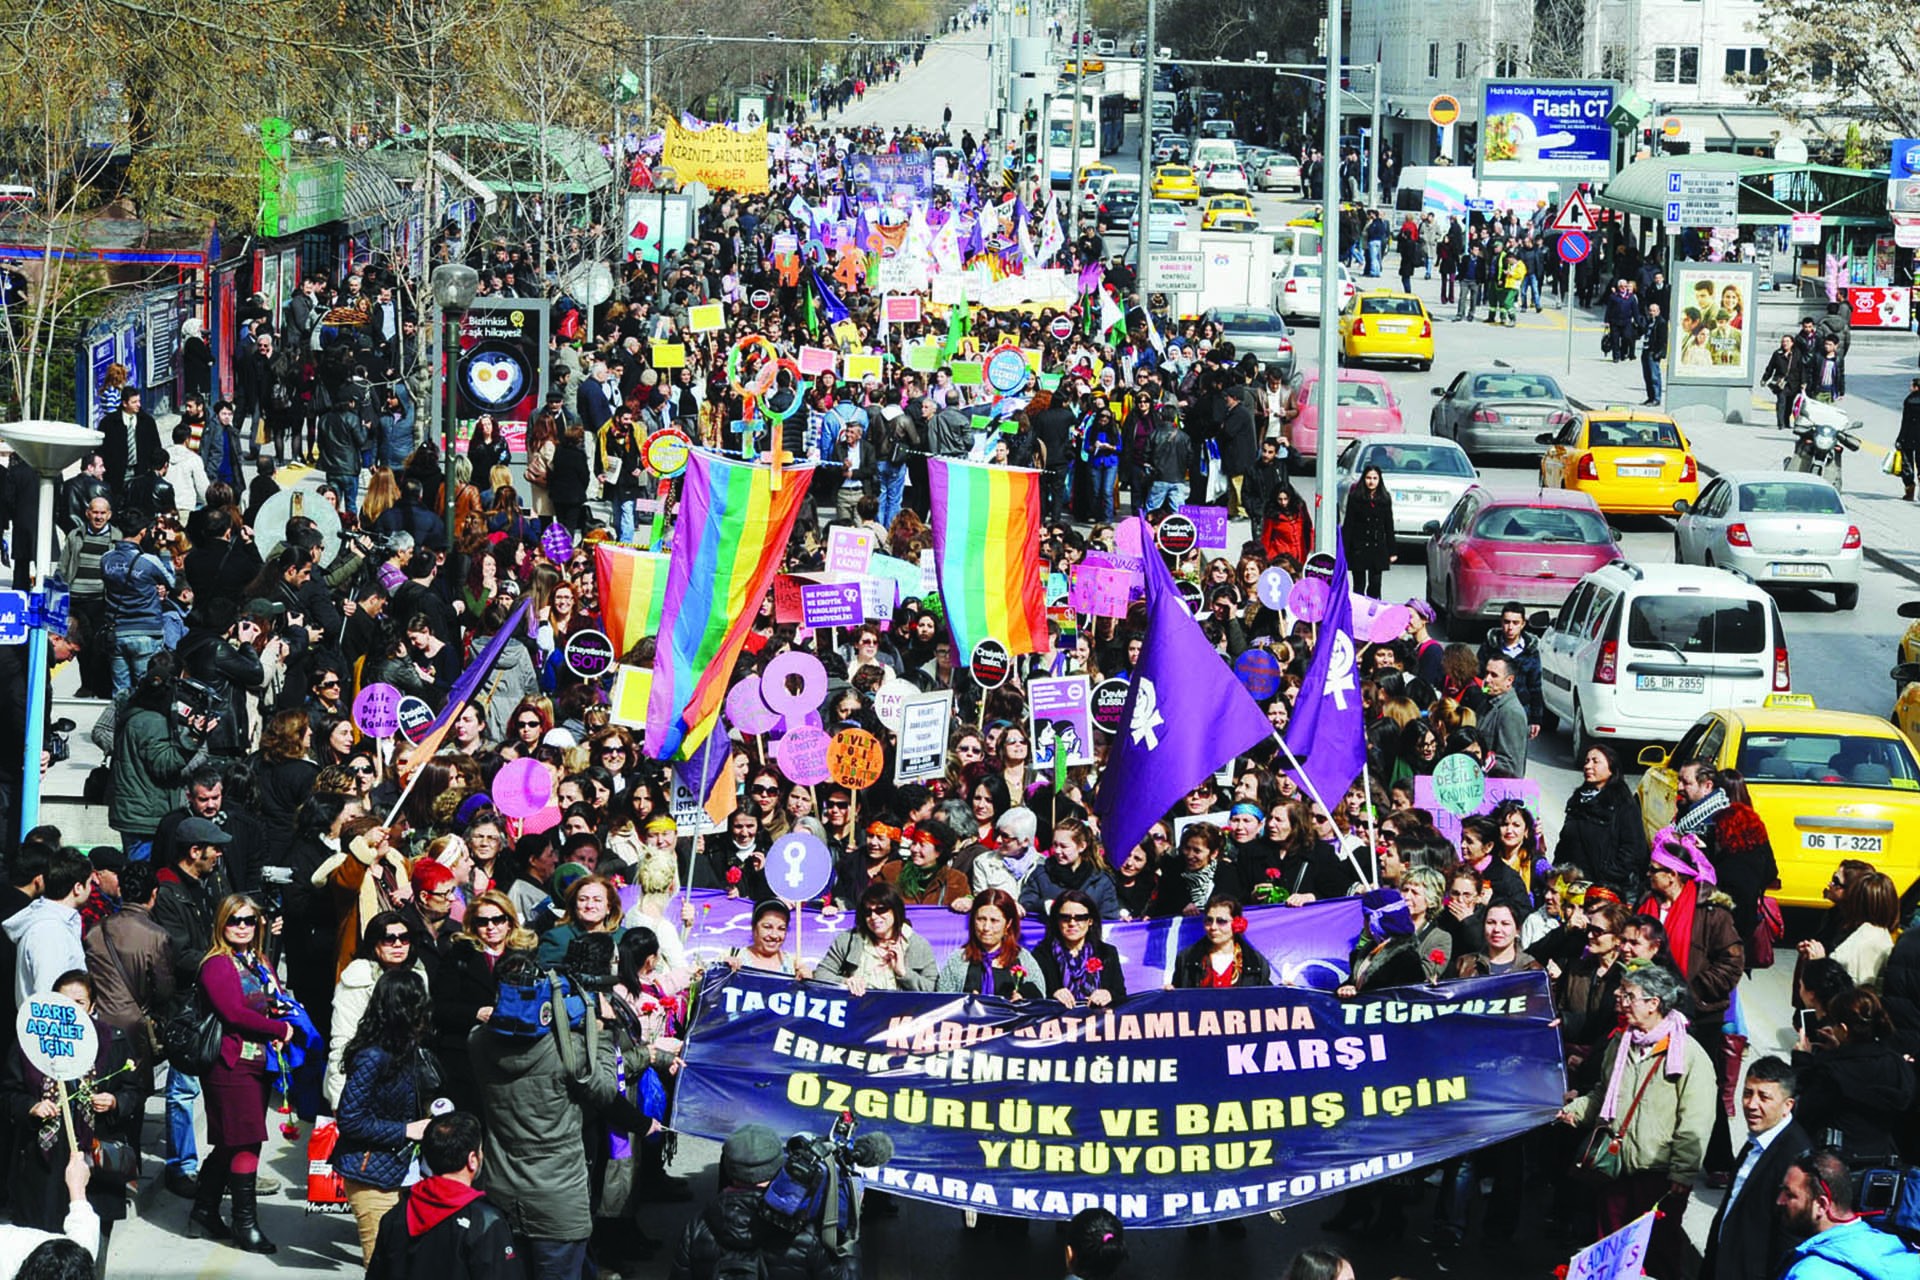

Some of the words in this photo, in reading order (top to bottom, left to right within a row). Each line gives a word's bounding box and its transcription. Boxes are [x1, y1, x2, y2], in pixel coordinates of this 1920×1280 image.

[1532, 99, 1581, 117] Flash
[1584, 99, 1609, 118] CT
[468, 316, 508, 326] Bizimkisi
[571, 653, 606, 670] son
[1644, 676, 1656, 687] 06
[881, 694, 902, 704] TAY
[1101, 689, 1128, 698] Devlet
[1807, 834, 1825, 848] 06
[1851, 837, 1882, 851] 3221
[31, 1002, 77, 1024] BARIŞ
[722, 986, 847, 1028] TACİZE
[26, 1018, 84, 1040] ADALET
[39, 1033, 74, 1058] İÇİN
[772, 1027, 890, 1072] ERKEK
[1226, 1034, 1387, 1075] KARŞI
[786, 1073, 1073, 1137] ÖZGÜRLÜK
[1100, 1107, 1159, 1138] VE
[1175, 1091, 1346, 1137] BARIŞ
[1361, 1075, 1467, 1116] İÇİN
[978, 1138, 1274, 1175] YÜRÜYORUZ
[852, 1165, 998, 1206] NKARA
[1012, 1187, 1147, 1218] KADIN
[1163, 1151, 1414, 1218] PLATFORMU
